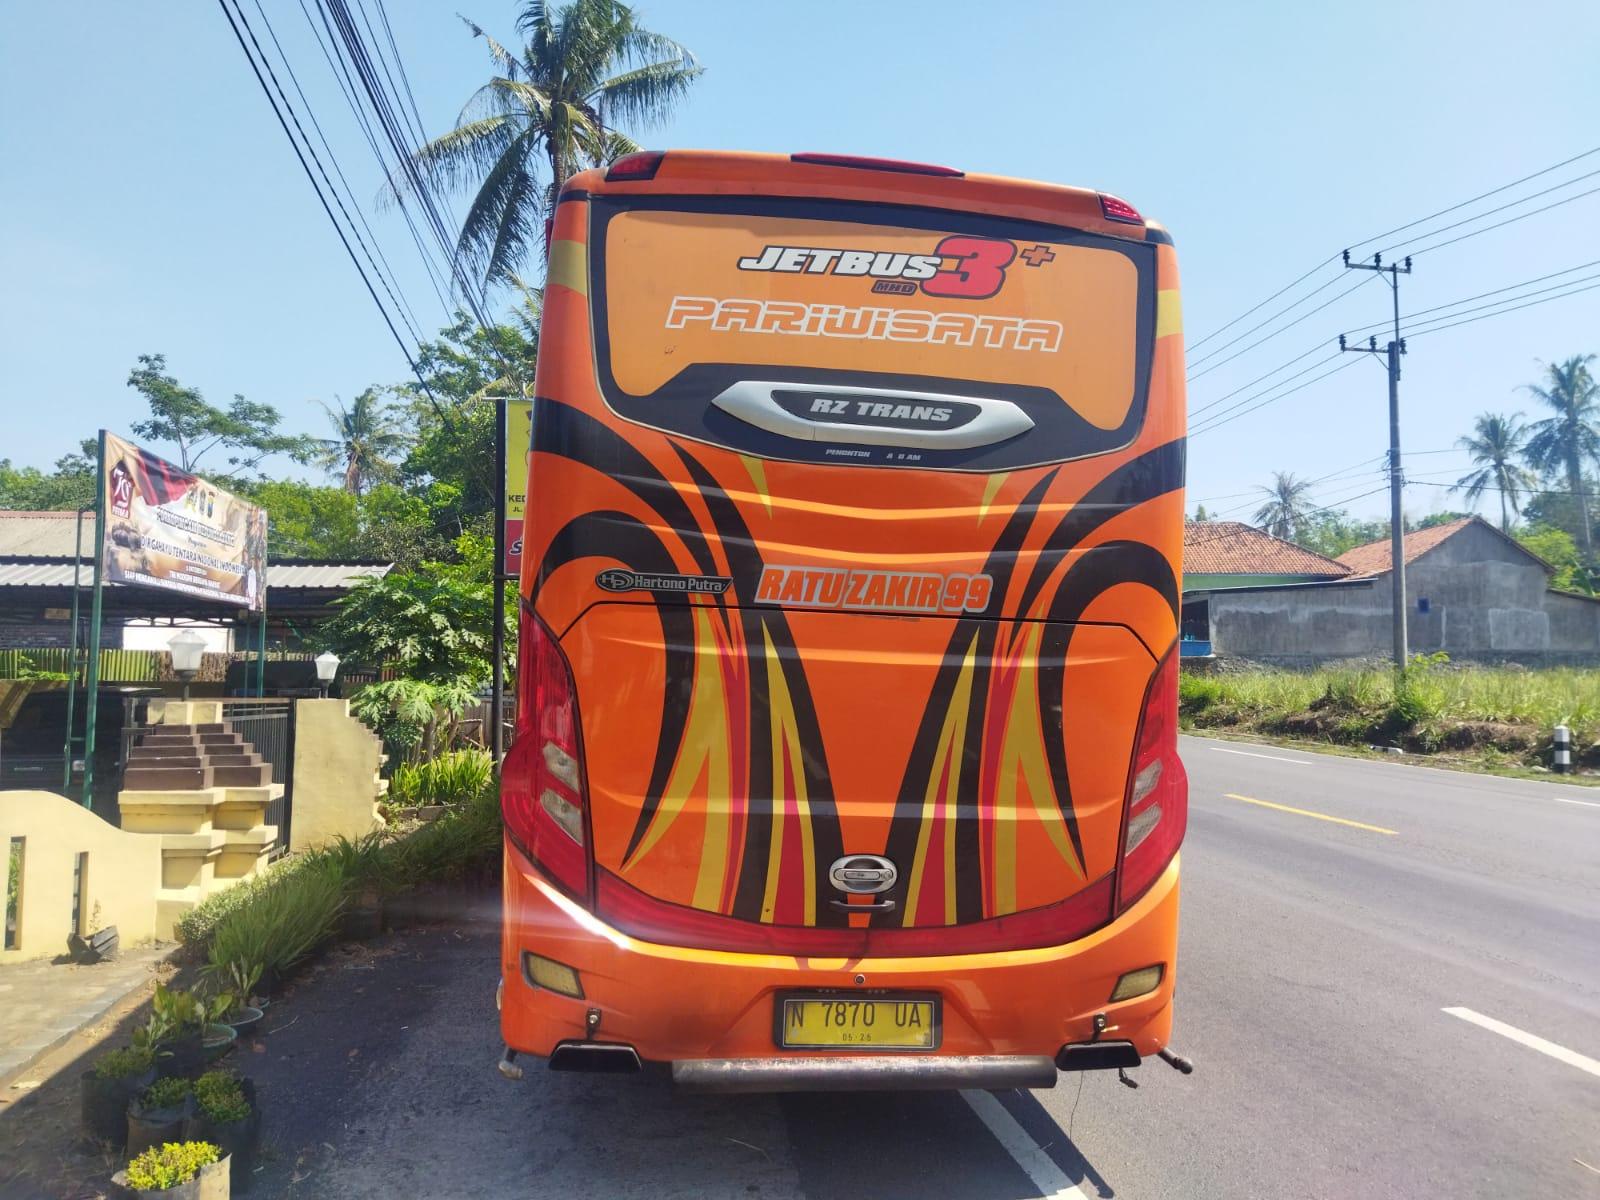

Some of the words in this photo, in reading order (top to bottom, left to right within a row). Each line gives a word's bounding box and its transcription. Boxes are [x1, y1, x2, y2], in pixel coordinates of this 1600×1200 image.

[737, 245, 942, 280] JETBUS
[664, 296, 1064, 353] PARIWISATA
[809, 398, 850, 415] RZ
[857, 401, 953, 422] TRANS
[173, 546, 197, 563] TENTARA
[635, 575, 686, 590] Hartono
[687, 578, 722, 592] Putra
[754, 564, 849, 607] RATU
[842, 570, 944, 612] ZAKIR
[941, 573, 994, 613] 99
[791, 1003, 805, 1028] N
[821, 1002, 876, 1028] 7870
[894, 1003, 922, 1028] UA
